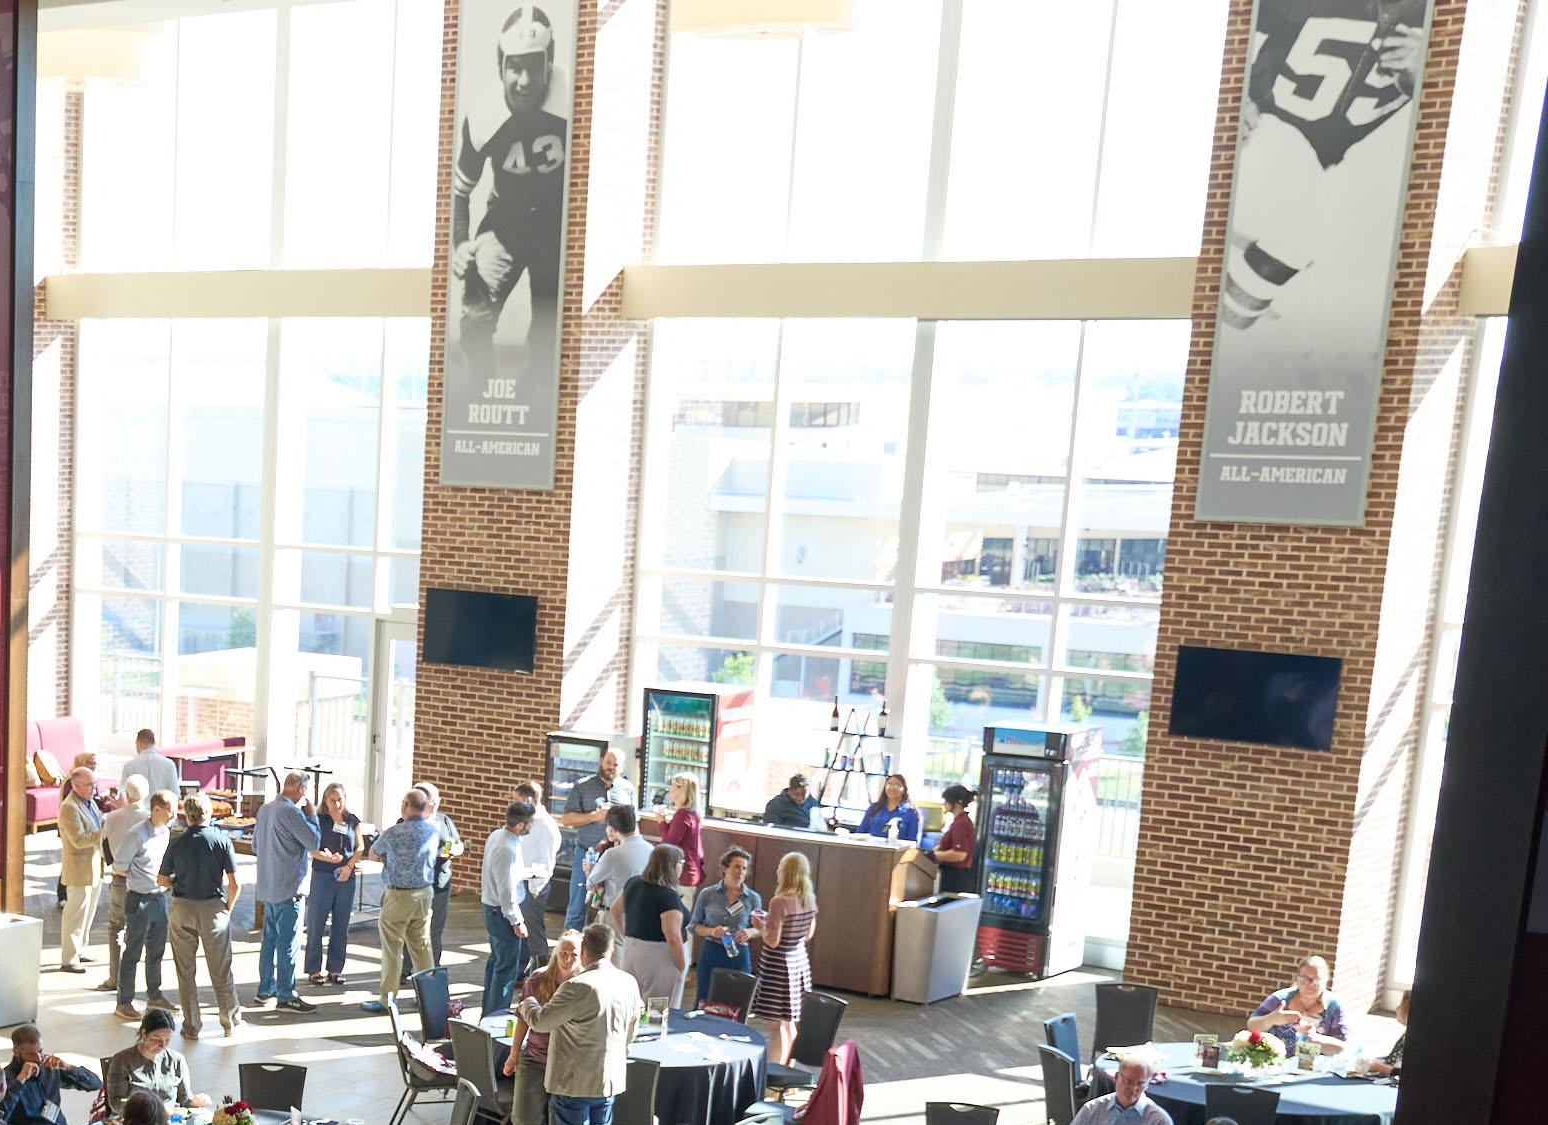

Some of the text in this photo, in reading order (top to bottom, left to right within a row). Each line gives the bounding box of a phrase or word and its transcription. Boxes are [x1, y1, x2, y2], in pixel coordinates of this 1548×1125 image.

[502, 134, 565, 175] 43
[482, 378, 516, 399] JOE
[1238, 389, 1345, 415] ROBERT
[467, 403, 530, 425] ROUTT
[1227, 421, 1349, 447] JACKSON
[454, 439, 541, 456] ALL-AMERICAN
[1219, 465, 1348, 485] ALL-AMERICAN
